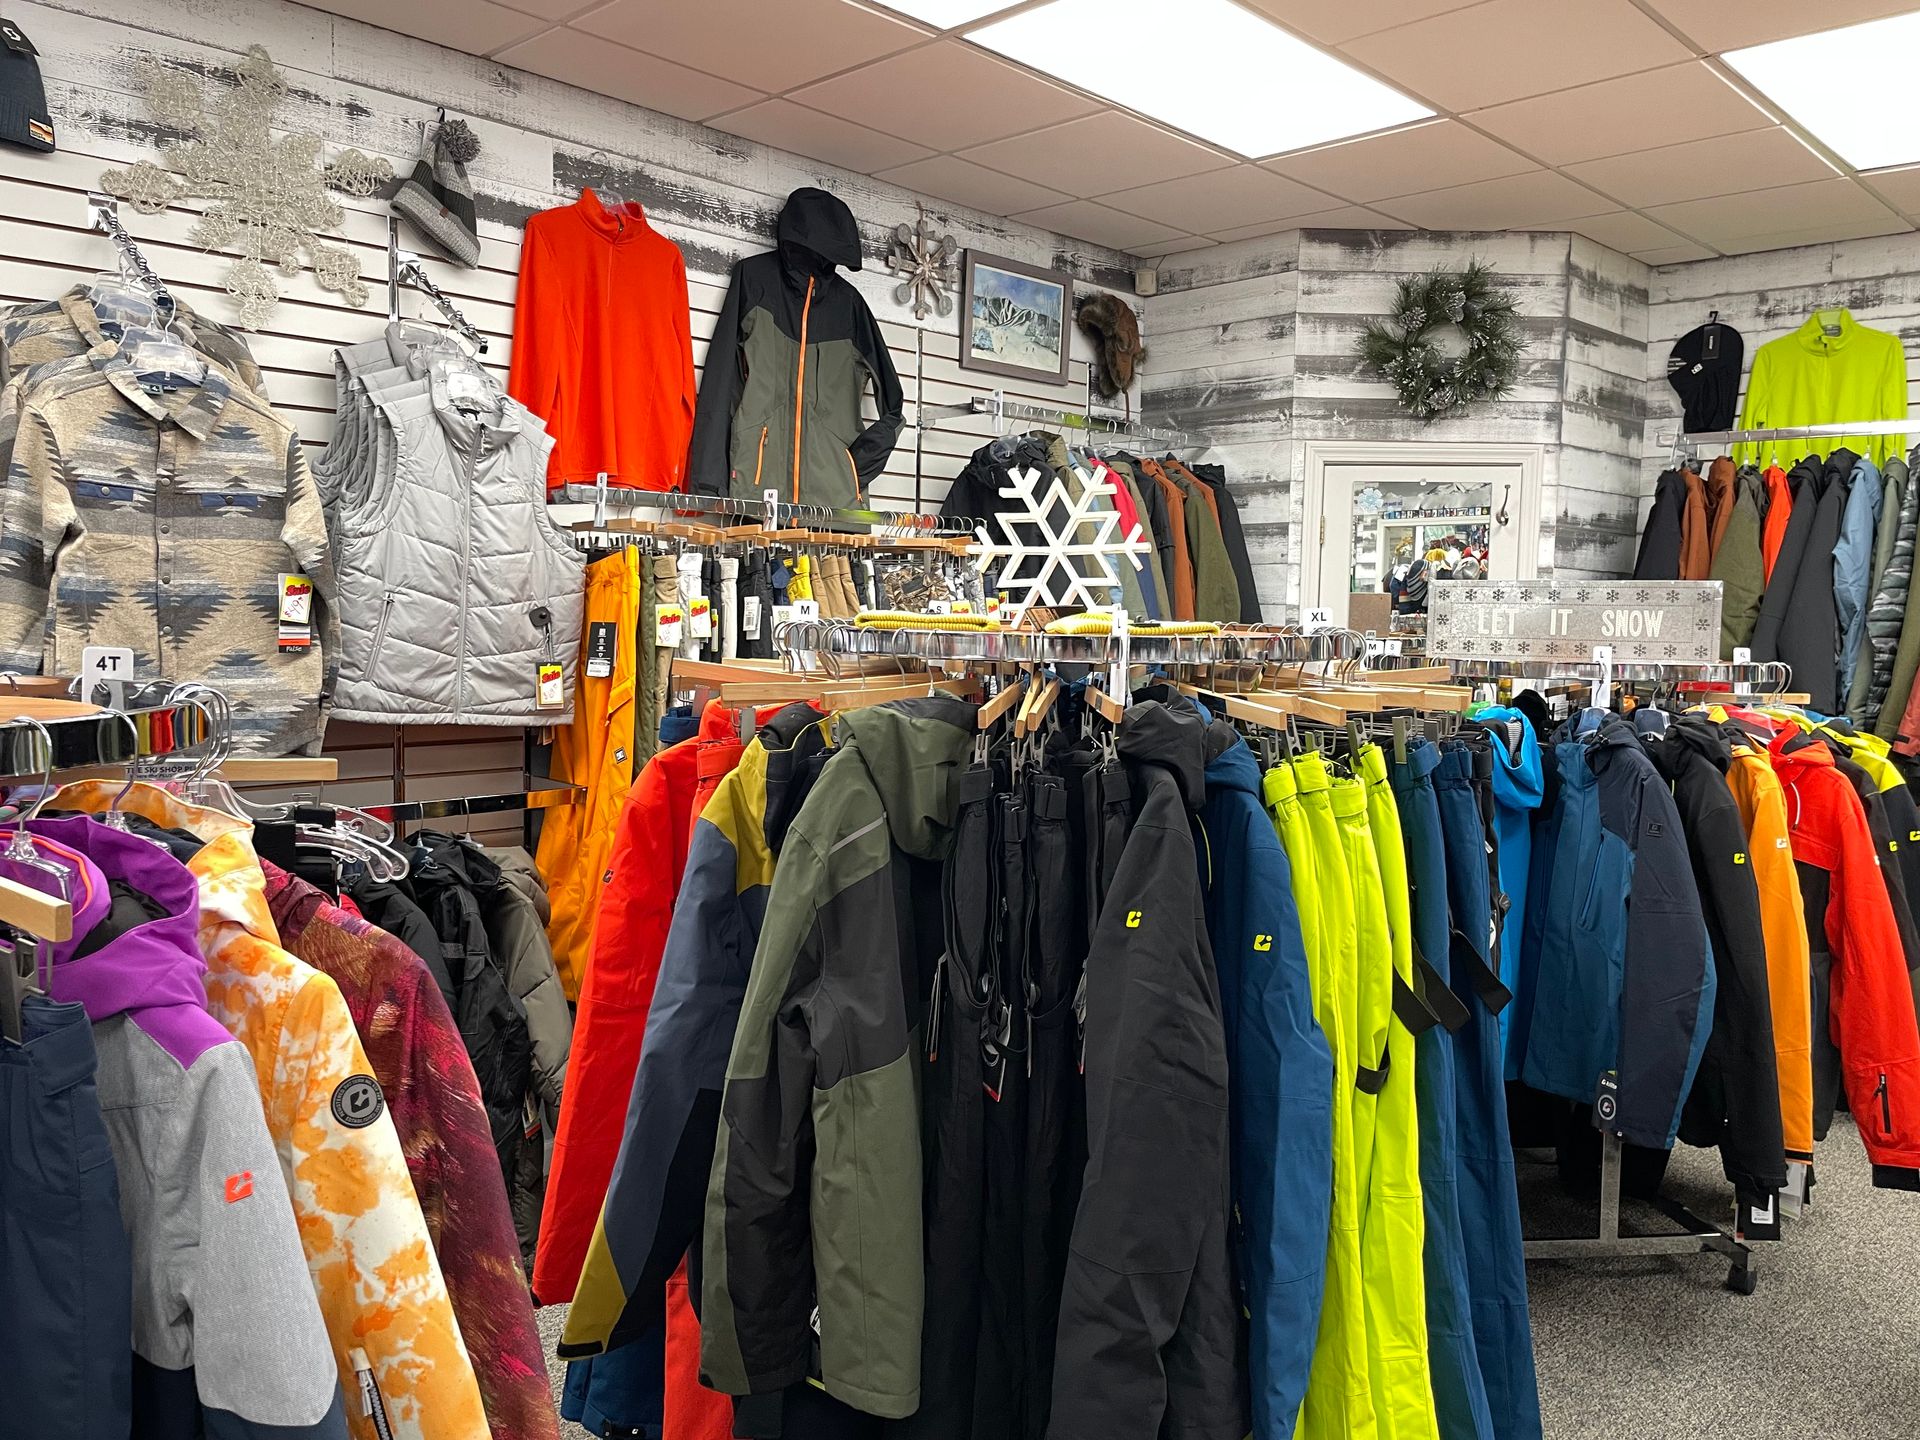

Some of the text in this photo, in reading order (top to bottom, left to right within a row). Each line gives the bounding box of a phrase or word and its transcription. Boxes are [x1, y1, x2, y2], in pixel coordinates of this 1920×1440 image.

[286, 584, 311, 596] Sale
[691, 605, 708, 617] Sale
[800, 605, 811, 615] M
[936, 605, 942, 614] S
[660, 614, 681, 625] Sale
[1311, 612, 1327, 622] XL
[1478, 608, 1664, 638] LET IT SNOW
[96, 656, 121, 671] 4T
[541, 670, 561, 684] Sale
